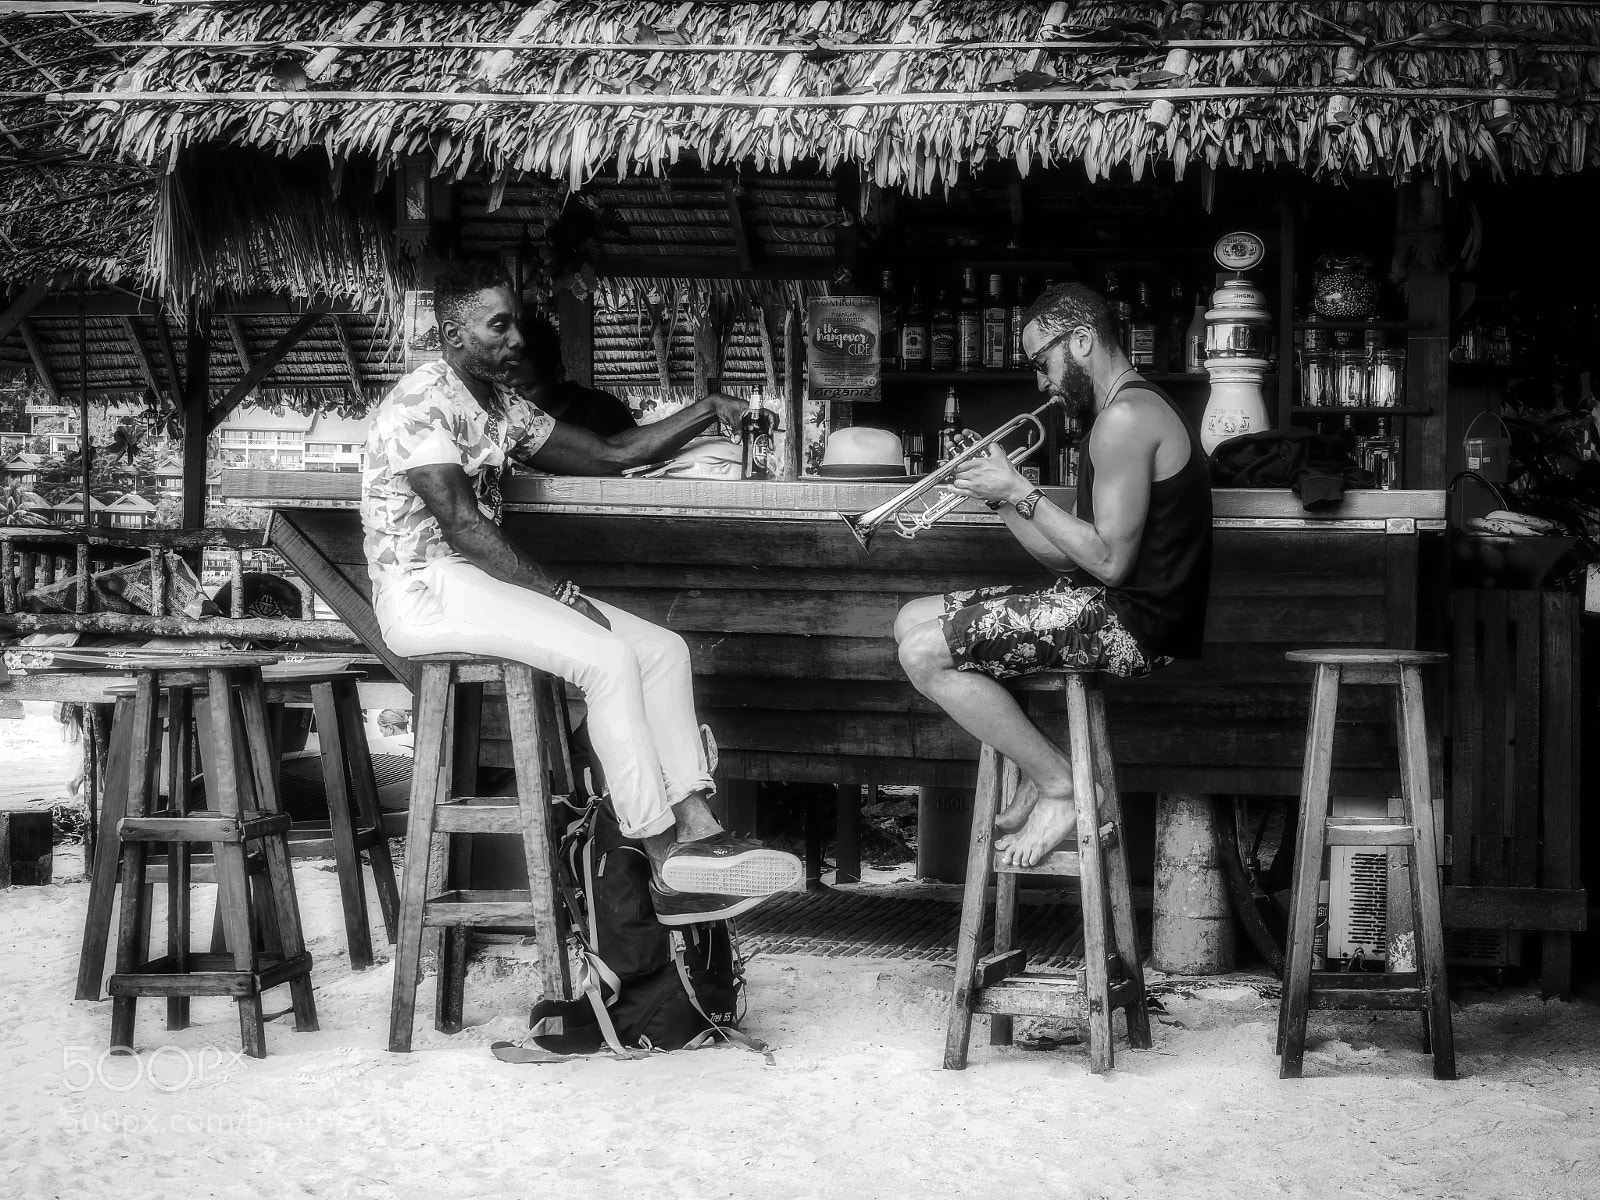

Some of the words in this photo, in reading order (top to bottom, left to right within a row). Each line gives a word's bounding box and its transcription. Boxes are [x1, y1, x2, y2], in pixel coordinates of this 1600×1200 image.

[815, 298, 877, 307] KOMBUCHA
[823, 323, 840, 334] the
[816, 327, 867, 349] hangover
[848, 343, 870, 356] CURE
[814, 387, 872, 399] organix
[710, 1012, 723, 1022] Trek
